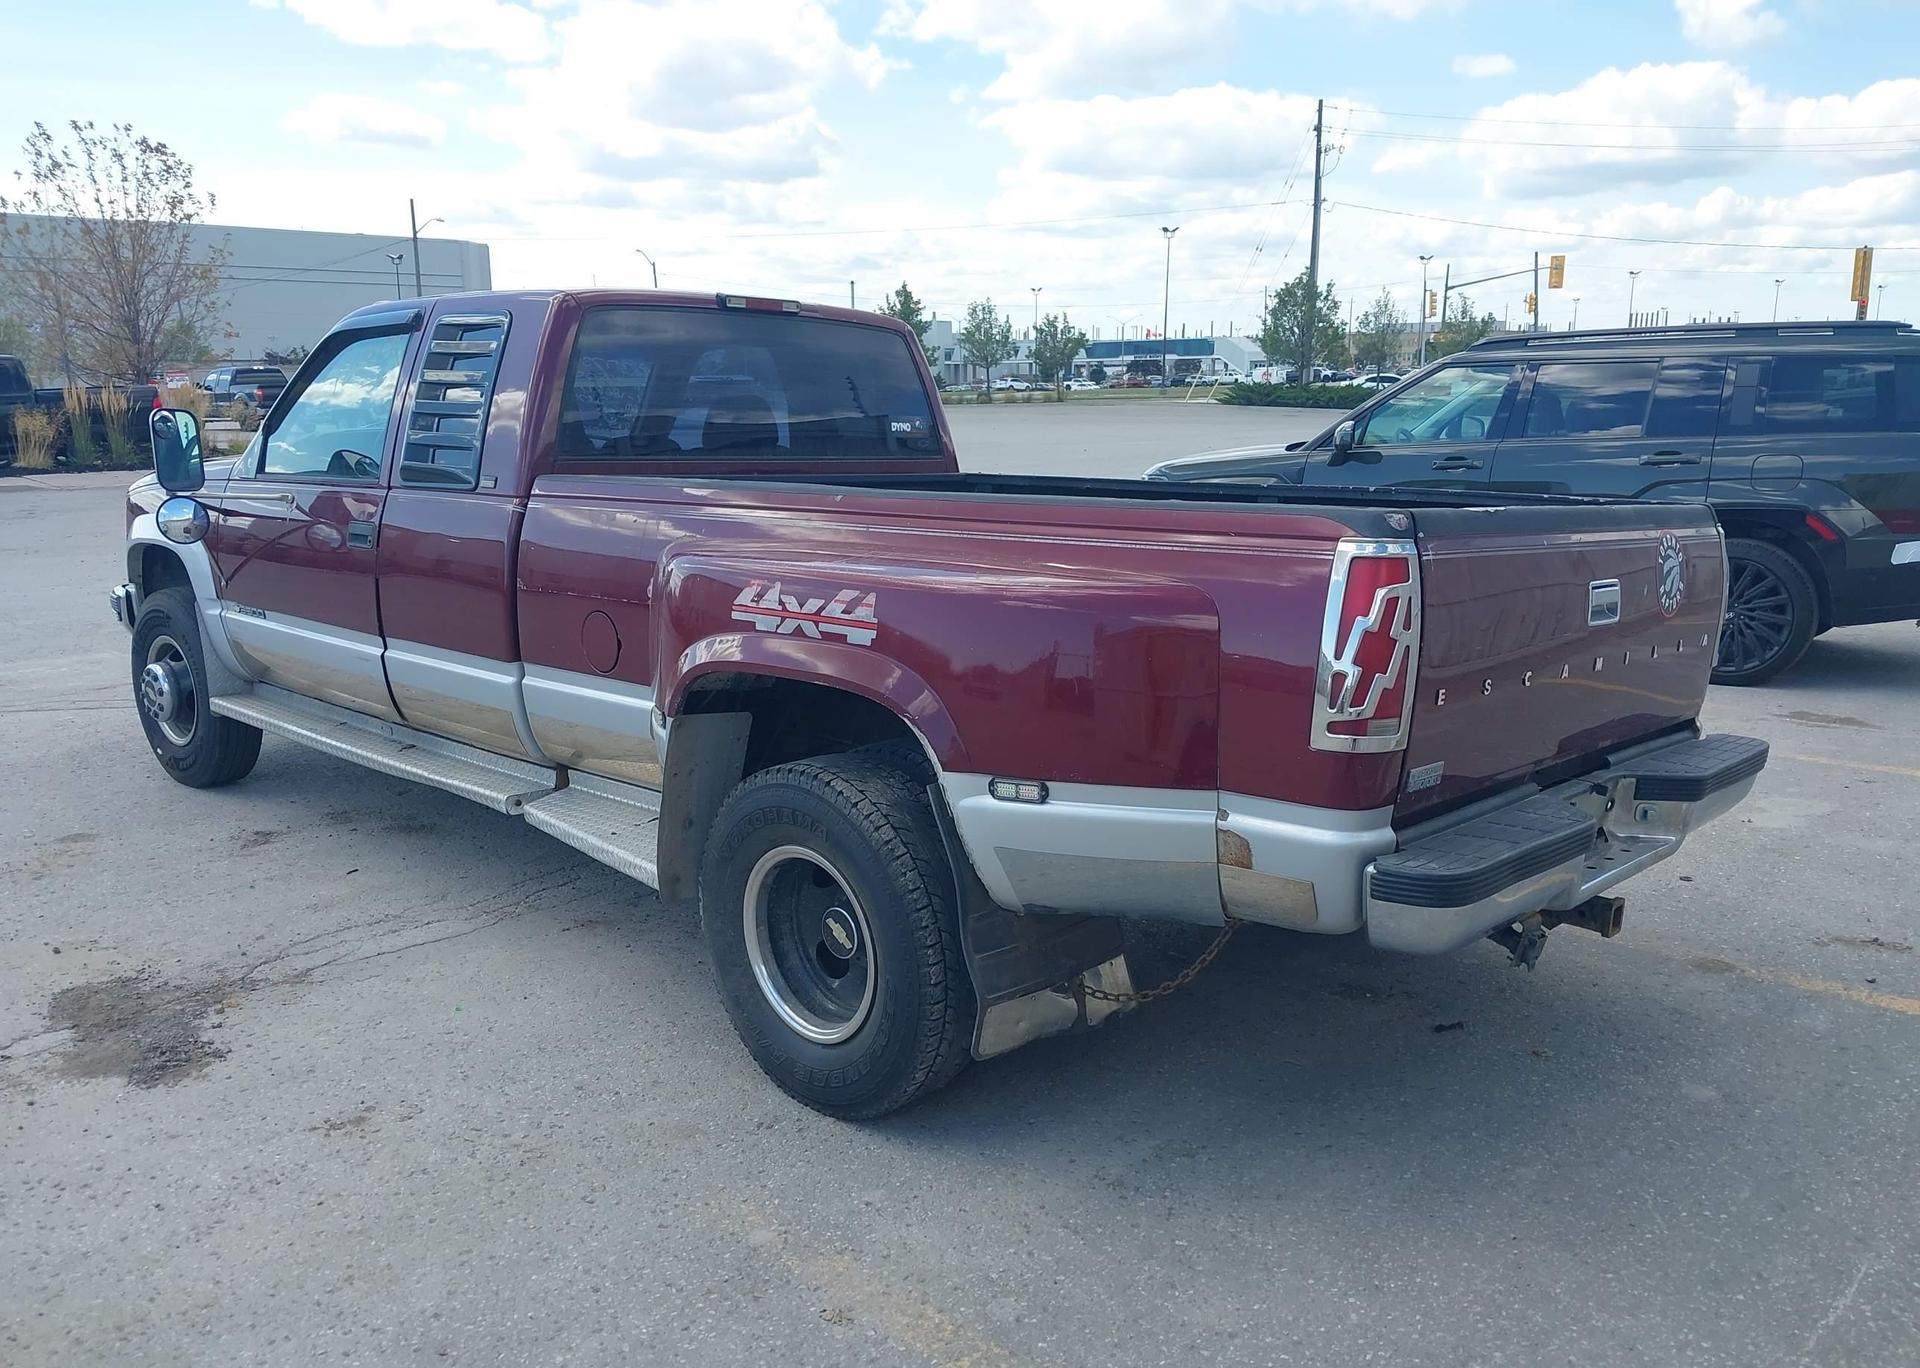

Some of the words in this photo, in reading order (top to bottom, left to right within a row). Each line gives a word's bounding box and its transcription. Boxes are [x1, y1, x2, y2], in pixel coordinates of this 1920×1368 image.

[891, 422, 911, 431] DYNO
[1659, 534, 1683, 564] TORONTO
[1660, 581, 1684, 612] RAPTORS
[731, 580, 878, 647] 4x4
[1435, 633, 1709, 706] ESCAMILLA
